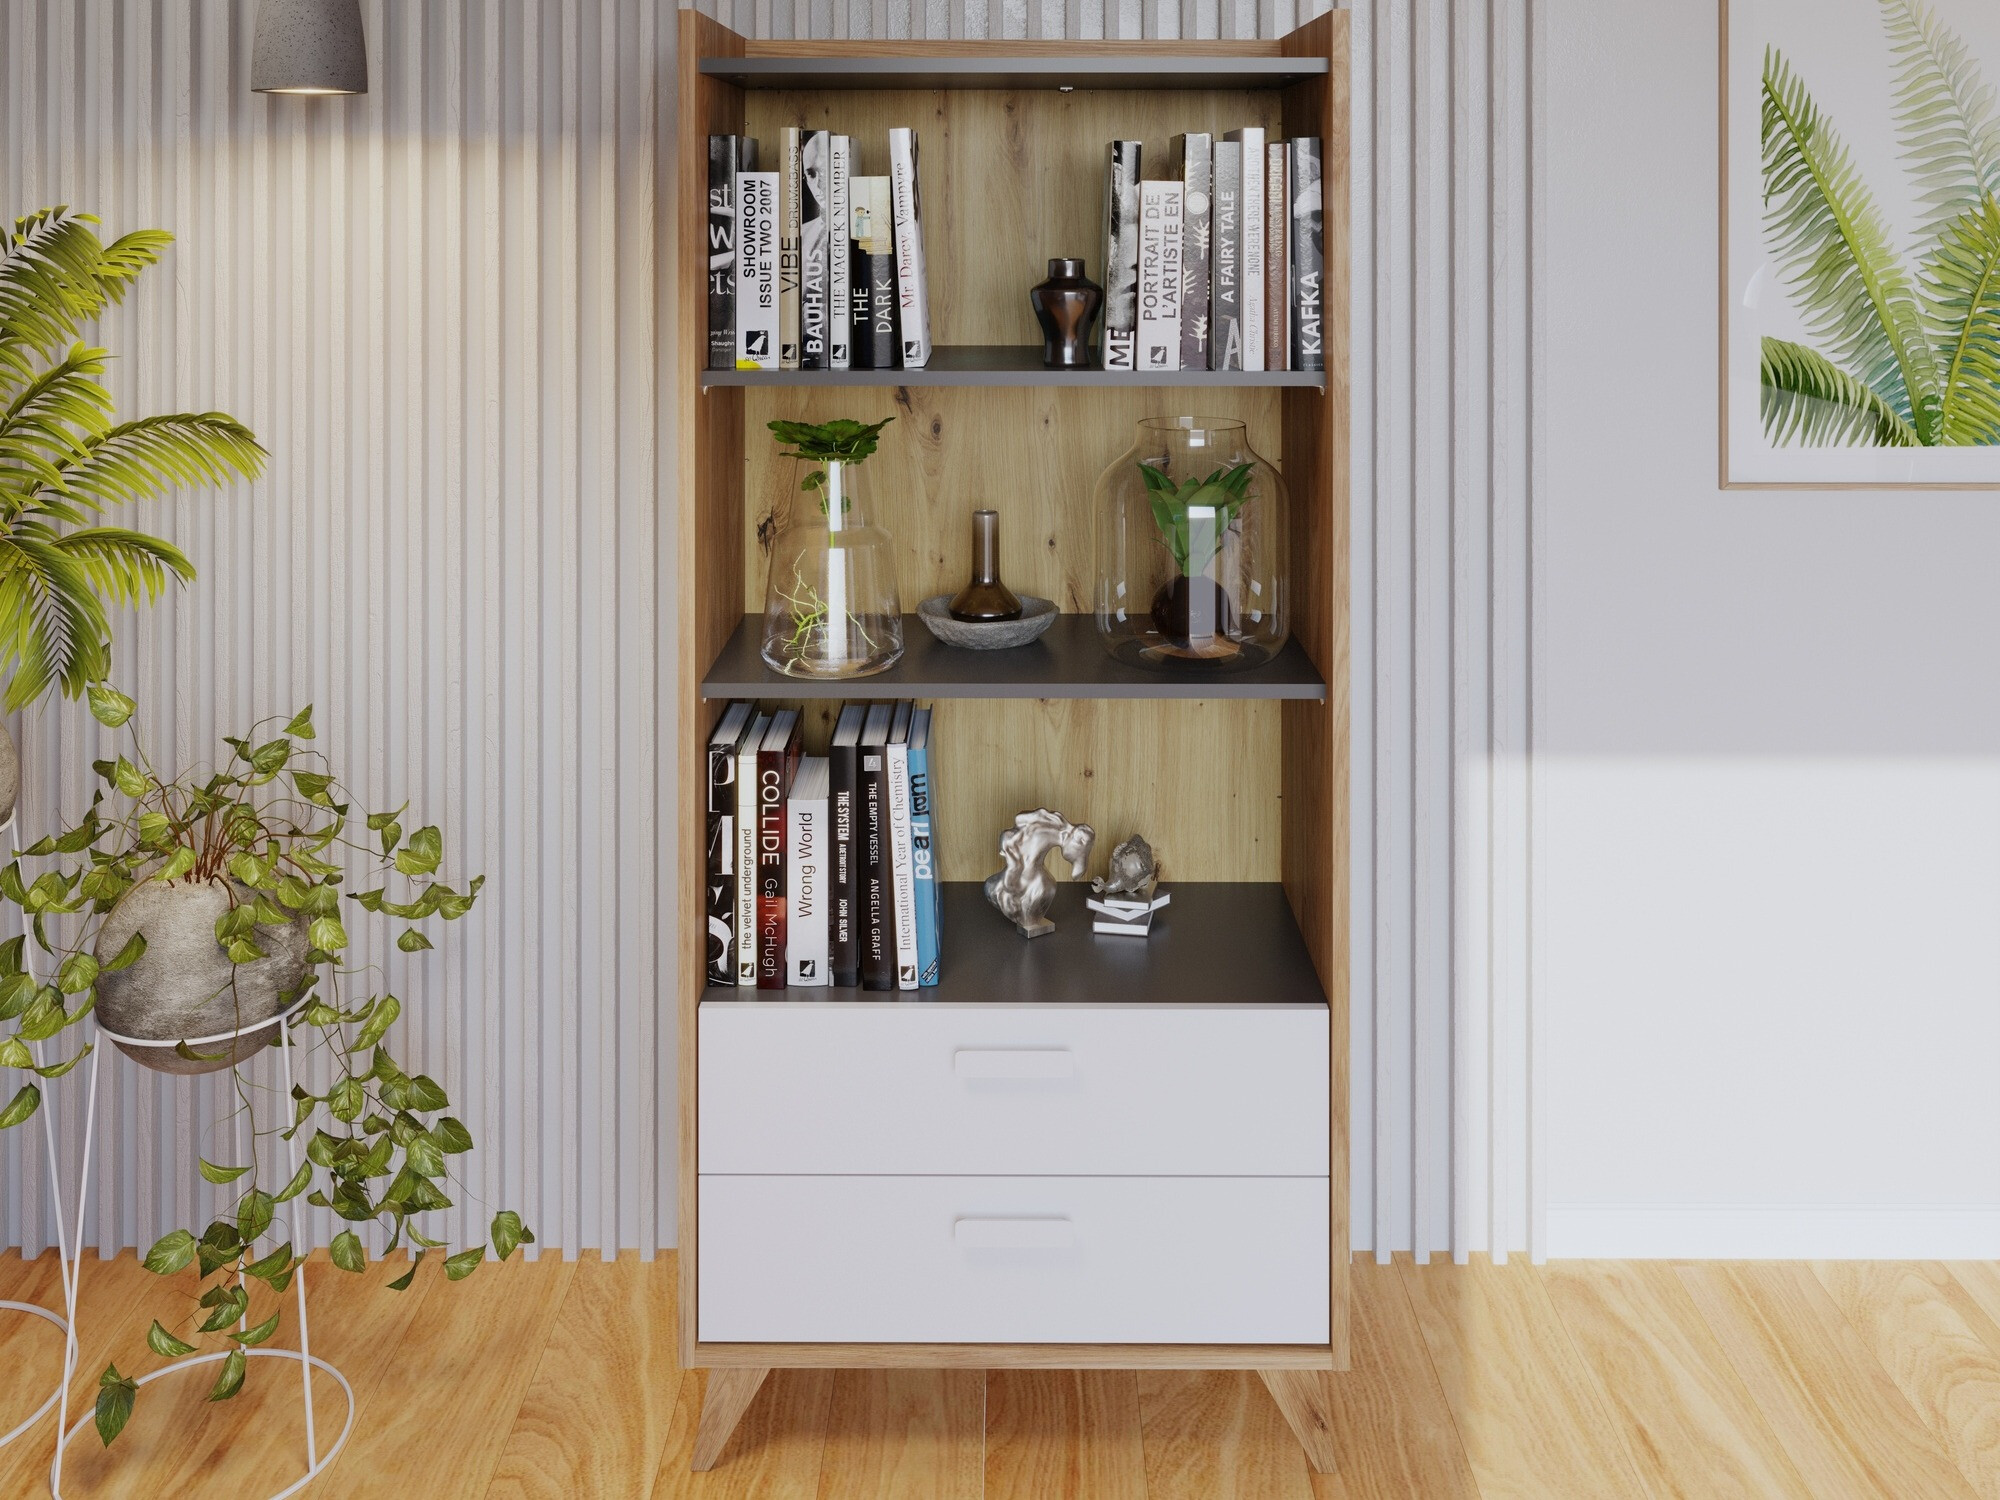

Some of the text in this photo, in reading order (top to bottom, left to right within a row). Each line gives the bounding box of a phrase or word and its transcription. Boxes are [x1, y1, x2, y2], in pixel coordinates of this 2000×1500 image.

[743, 179, 756, 278] SHOWROOM
[781, 145, 799, 294] VIBE DRUM&BASS
[834, 151, 846, 319] THE MAGICK NUMBER
[896, 162, 910, 227] Vampyre
[1164, 192, 1180, 217] EN
[760, 180, 772, 309] ISSUE TWO 2007
[1143, 194, 1160, 321] PORTRAIT DE
[1220, 191, 1235, 303] A FAIRY TALE
[1247, 225, 1260, 250] WERE
[1247, 251, 1260, 277] NONE
[806, 249, 824, 353] BAUHAUS
[853, 288, 869, 326] THE
[875, 278, 893, 333] DARK
[901, 284, 915, 309] Mr.
[1300, 270, 1321, 355] KAFKA
[798, 812, 817, 918] Wrong World
[868, 782, 879, 866] THE EMPTY VESSEL
[891, 758, 911, 951] International Year of Chemistry
[911, 822, 933, 880] pearl
[742, 828, 754, 950] the velvet underground
[762, 770, 780, 977] COLLIDE Gail McHugh
[838, 898, 848, 943] JOHN SILVER
[870, 878, 881, 961] ANGELLA GRAFF
